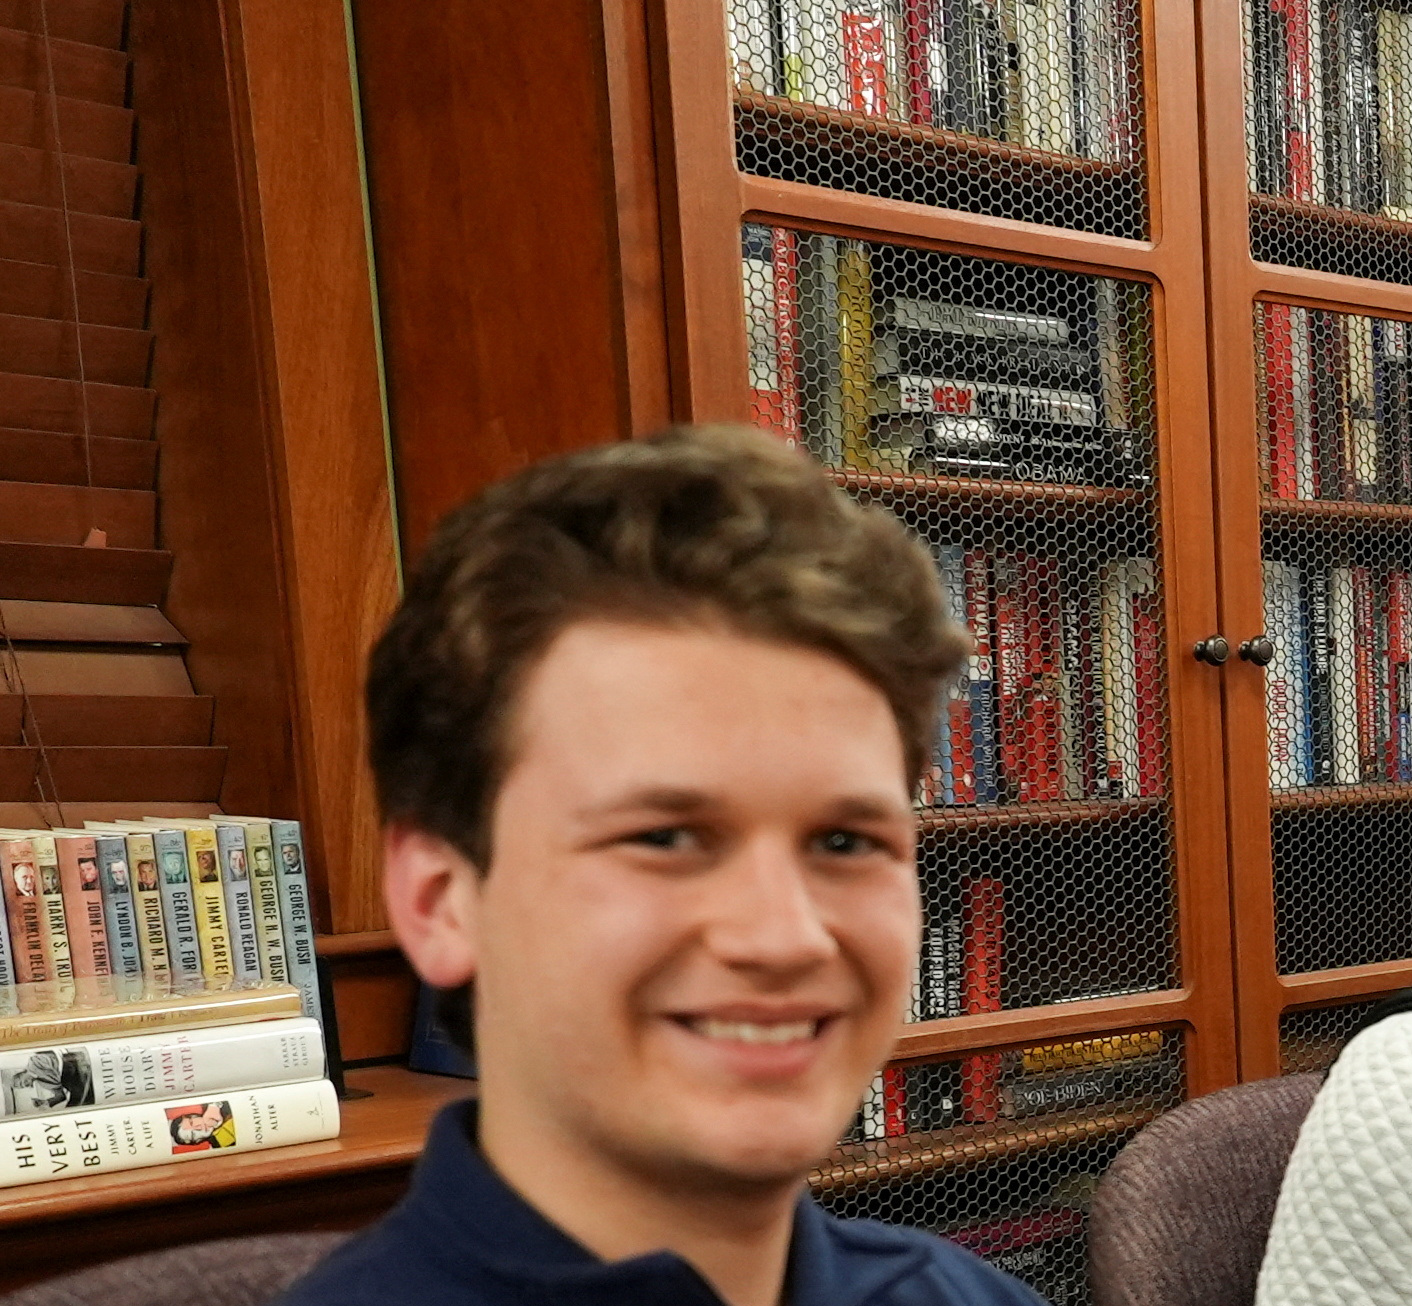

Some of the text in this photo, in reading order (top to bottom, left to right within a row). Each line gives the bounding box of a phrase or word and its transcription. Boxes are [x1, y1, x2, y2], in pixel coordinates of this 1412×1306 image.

[1015, 462, 1086, 483] OBAMA
[22, 901, 42, 953] FRANKLIN
[47, 900, 66, 938] HARRY
[86, 900, 103, 927] JOHN
[90, 929, 104, 938] F.
[115, 901, 134, 953] LYNDON B.
[143, 897, 166, 961] RICHARD M.
[172, 891, 198, 975] GERALD R. FOR
[205, 895, 224, 930] JIMMY
[236, 891, 258, 972] RONALD REAGAN
[259, 880, 285, 983] GEORGE H. W. BUSH
[288, 884, 312, 965] GEORGE W. BUSH
[53, 941, 68, 953] S.
[303, 983, 316, 1018] JAME
[98, 1047, 116, 1100] WHITE
[119, 1045, 137, 1096] HOUSE
[177, 1034, 195, 1094] CARTER
[106, 1123, 121, 1156] JIMMY
[141, 1120, 152, 1140] LIFE
[249, 1095, 263, 1145] JONATHAN
[268, 1103, 280, 1132] ALTER
[12, 1133, 37, 1170] HIS
[42, 1122, 70, 1174] VERY
[74, 1119, 101, 1168] BEST
